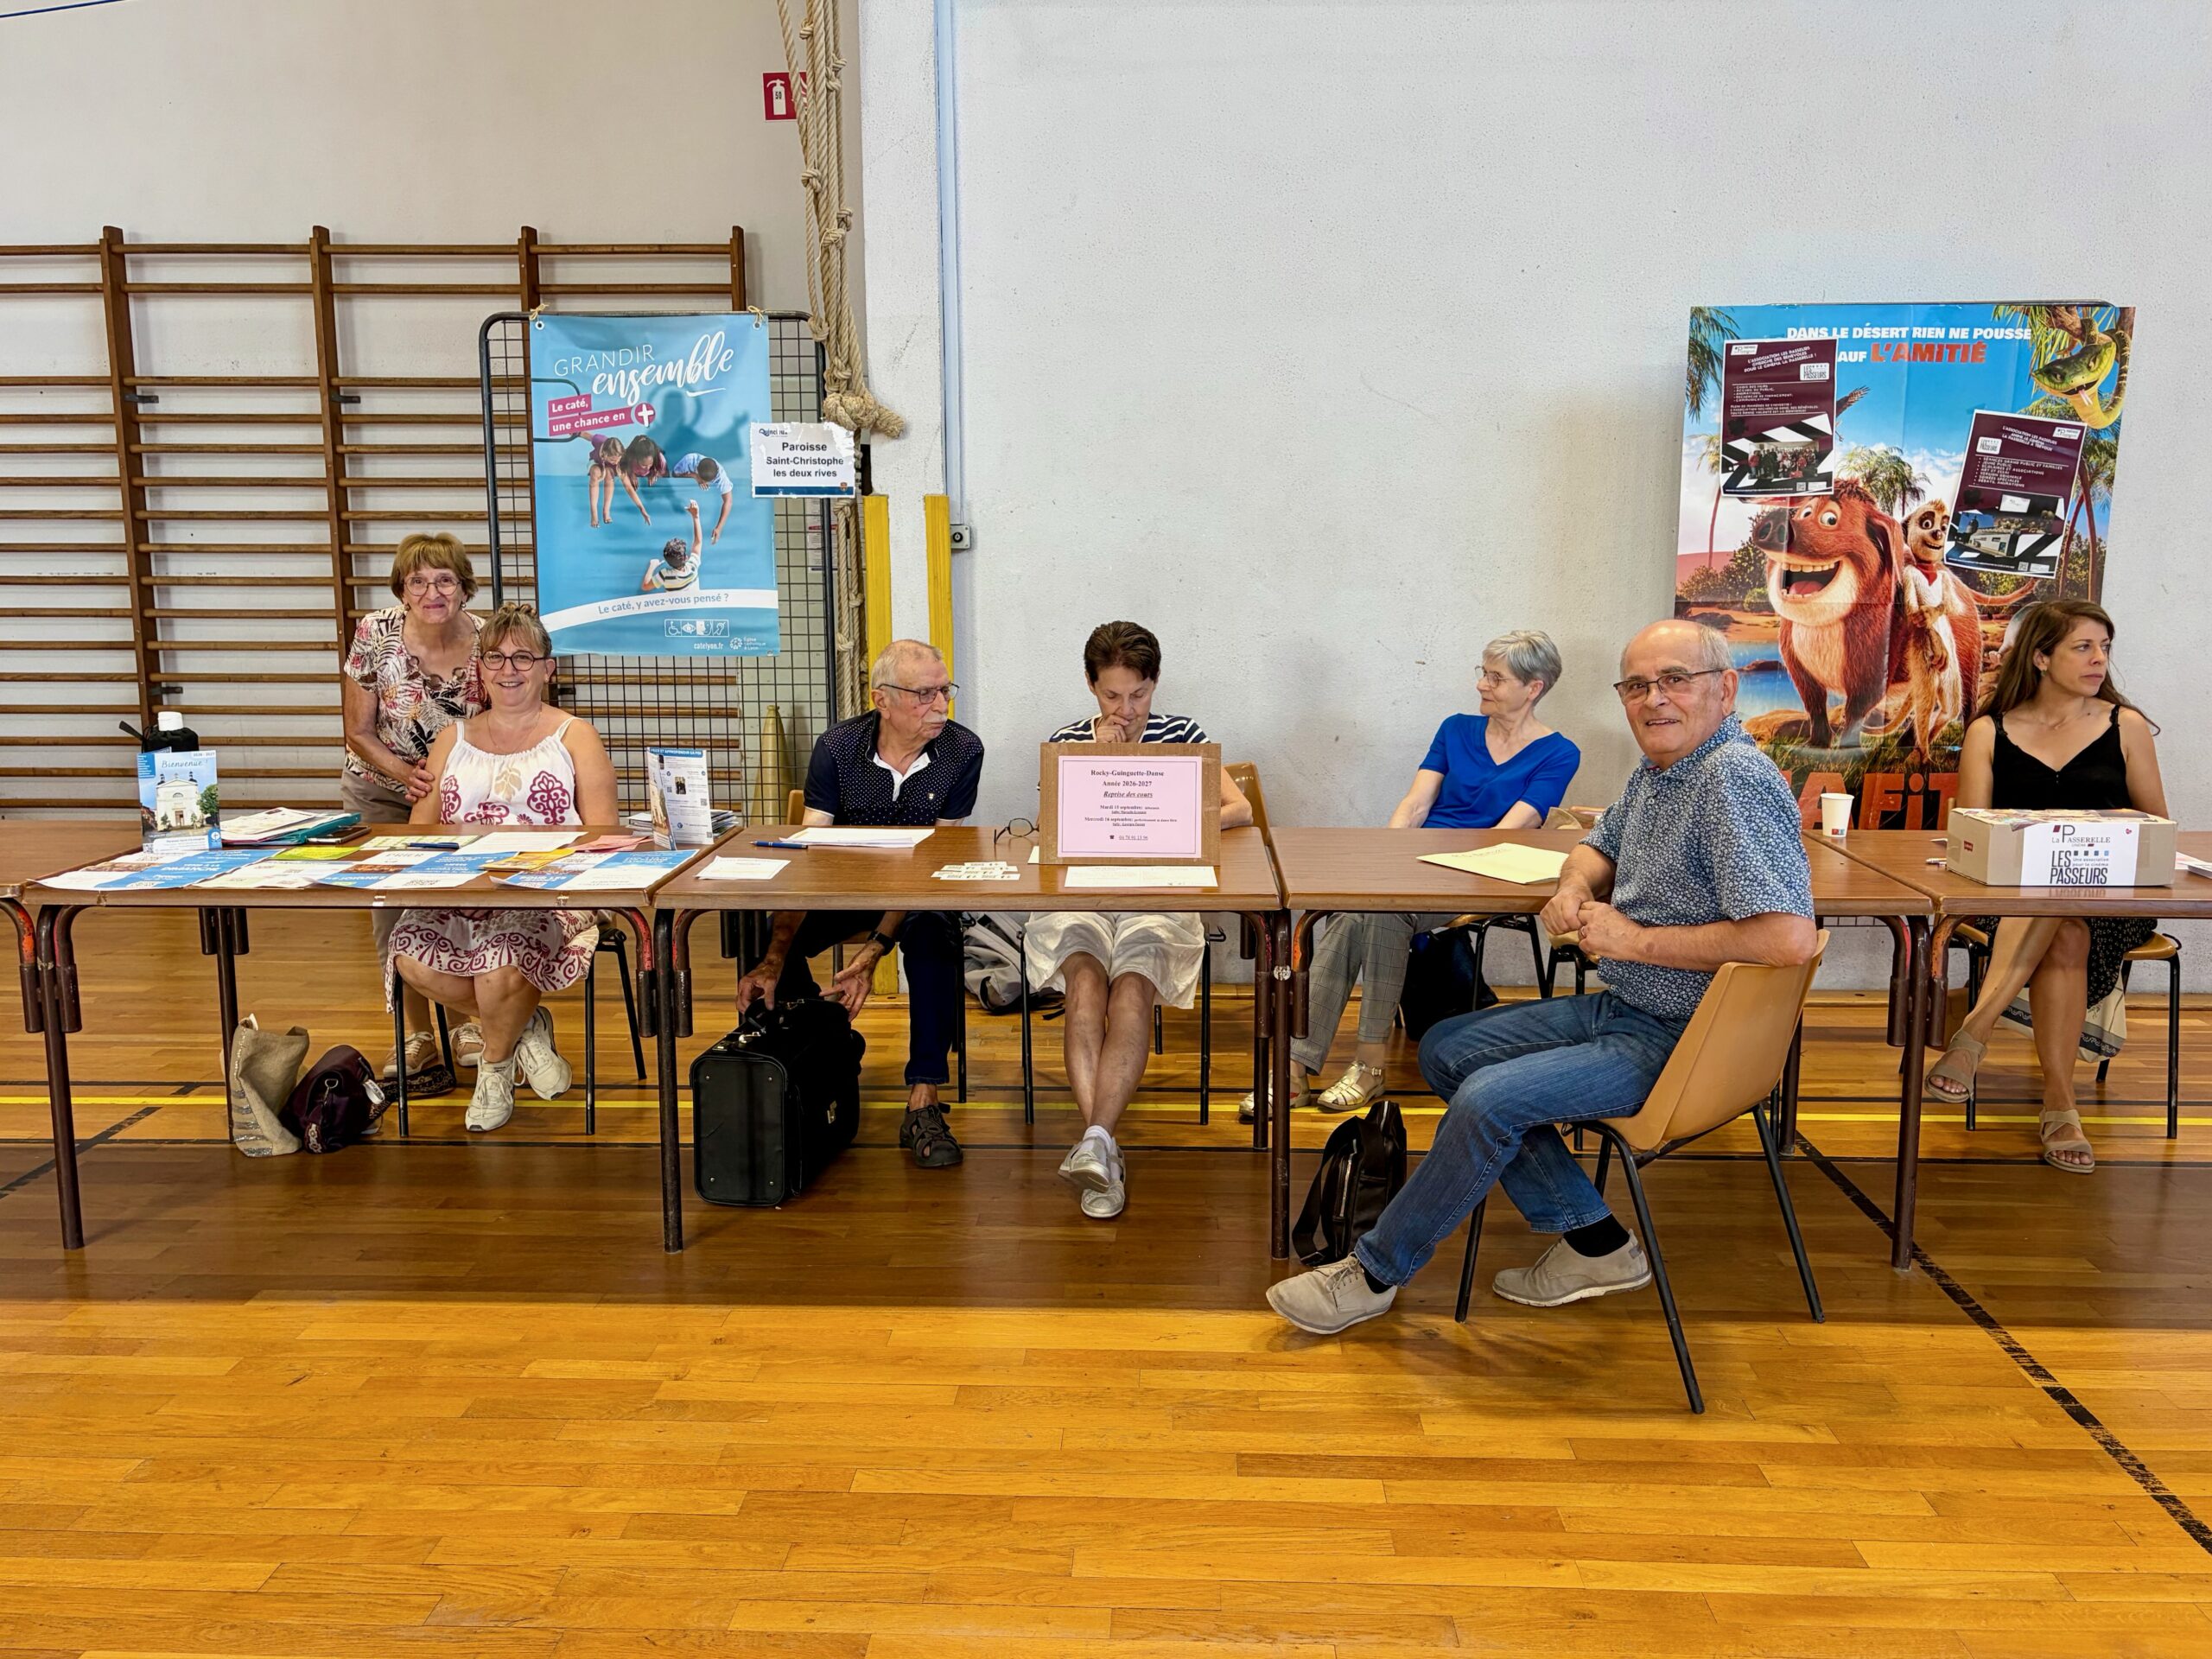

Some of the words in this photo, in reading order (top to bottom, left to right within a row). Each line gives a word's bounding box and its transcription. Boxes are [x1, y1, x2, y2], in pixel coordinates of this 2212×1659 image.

[1787, 327, 1828, 338] DANS
[1833, 327, 1849, 338] LE
[1852, 323, 1909, 339] DÉSERT
[1912, 327, 1945, 339] RIEN
[1948, 327, 1969, 339] NE
[1973, 328, 2032, 340] POUSSE
[554, 344, 655, 377] GRANDIR
[1838, 351, 1867, 362] AUF
[592, 331, 734, 406] ensemble
[1803, 371, 1827, 379] PASSEURS
[552, 403, 563, 413] Le
[565, 397, 588, 411] caté,
[552, 422, 571, 432] une
[574, 413, 610, 428] chance
[613, 412, 626, 422] en
[782, 442, 827, 451] Paroisse
[766, 456, 844, 467] Saint-Christophe
[598, 605, 609, 614] Le
[612, 601, 634, 613] caté,
[644, 597, 691, 608] avez-vous
[694, 594, 721, 605] pensé
[724, 593, 729, 601] ?
[694, 642, 724, 651] catelyon.fr
[162, 760, 203, 768] Bienvenue
[2062, 824, 2111, 843] PASSERELLE
[2051, 850, 2071, 868] LES
[2050, 868, 2108, 884] PASSEURS
